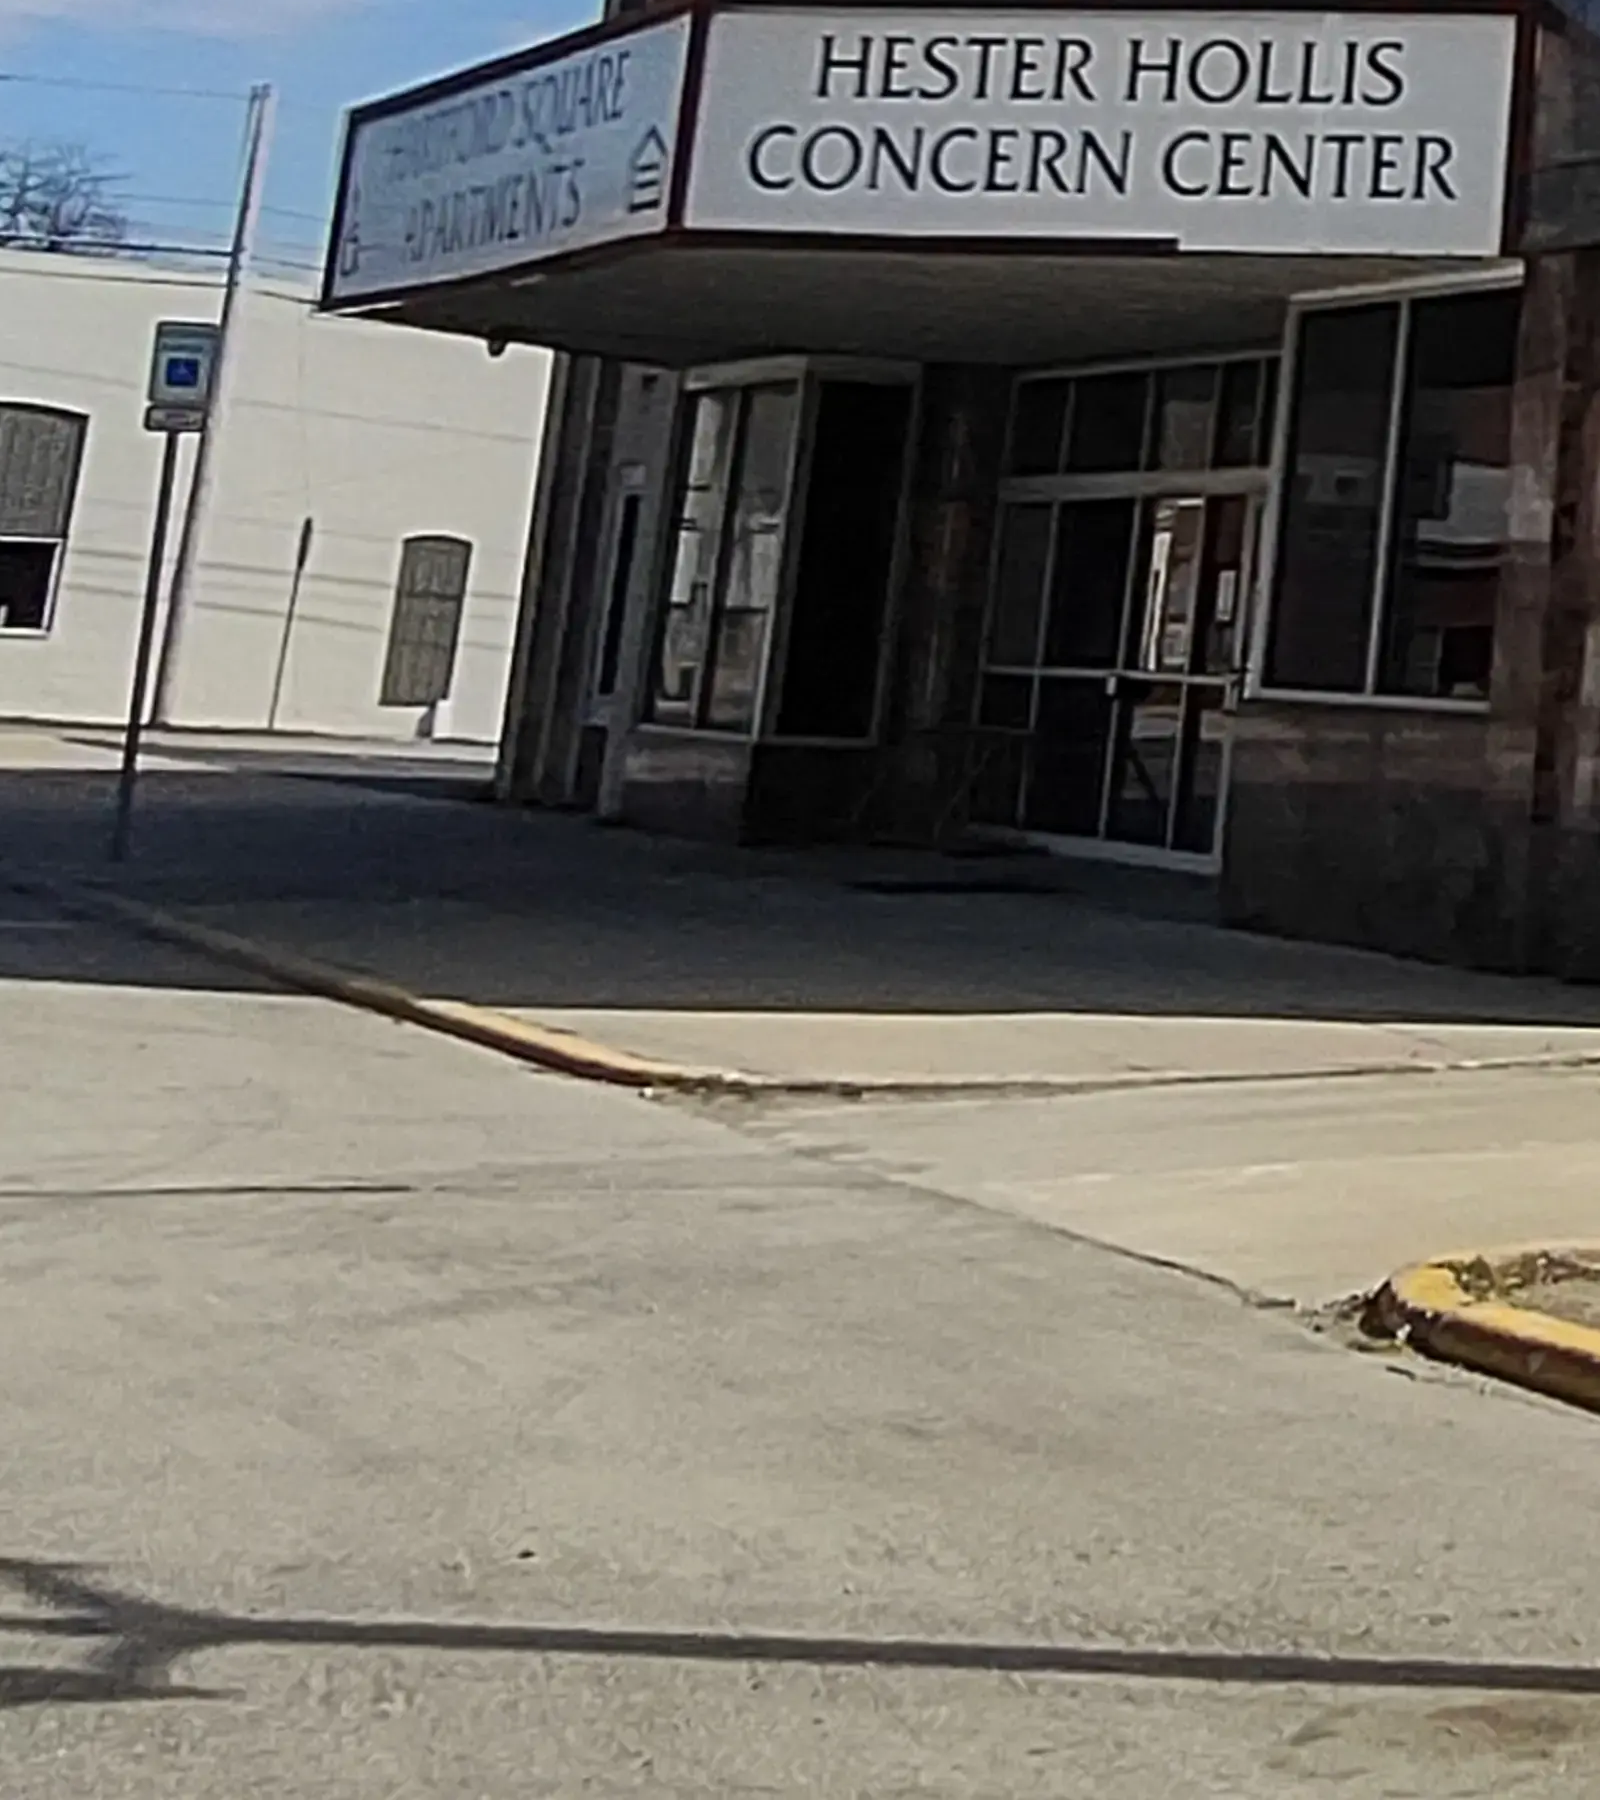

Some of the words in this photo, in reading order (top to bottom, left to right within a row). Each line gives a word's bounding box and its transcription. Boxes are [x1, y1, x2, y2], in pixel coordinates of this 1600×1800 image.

[514, 50, 630, 155] SQUARE
[815, 35, 1096, 100] HESTER
[1123, 38, 1405, 105] HOLLIS
[748, 124, 1131, 195] CONCERN
[1161, 130, 1457, 200] CENTER
